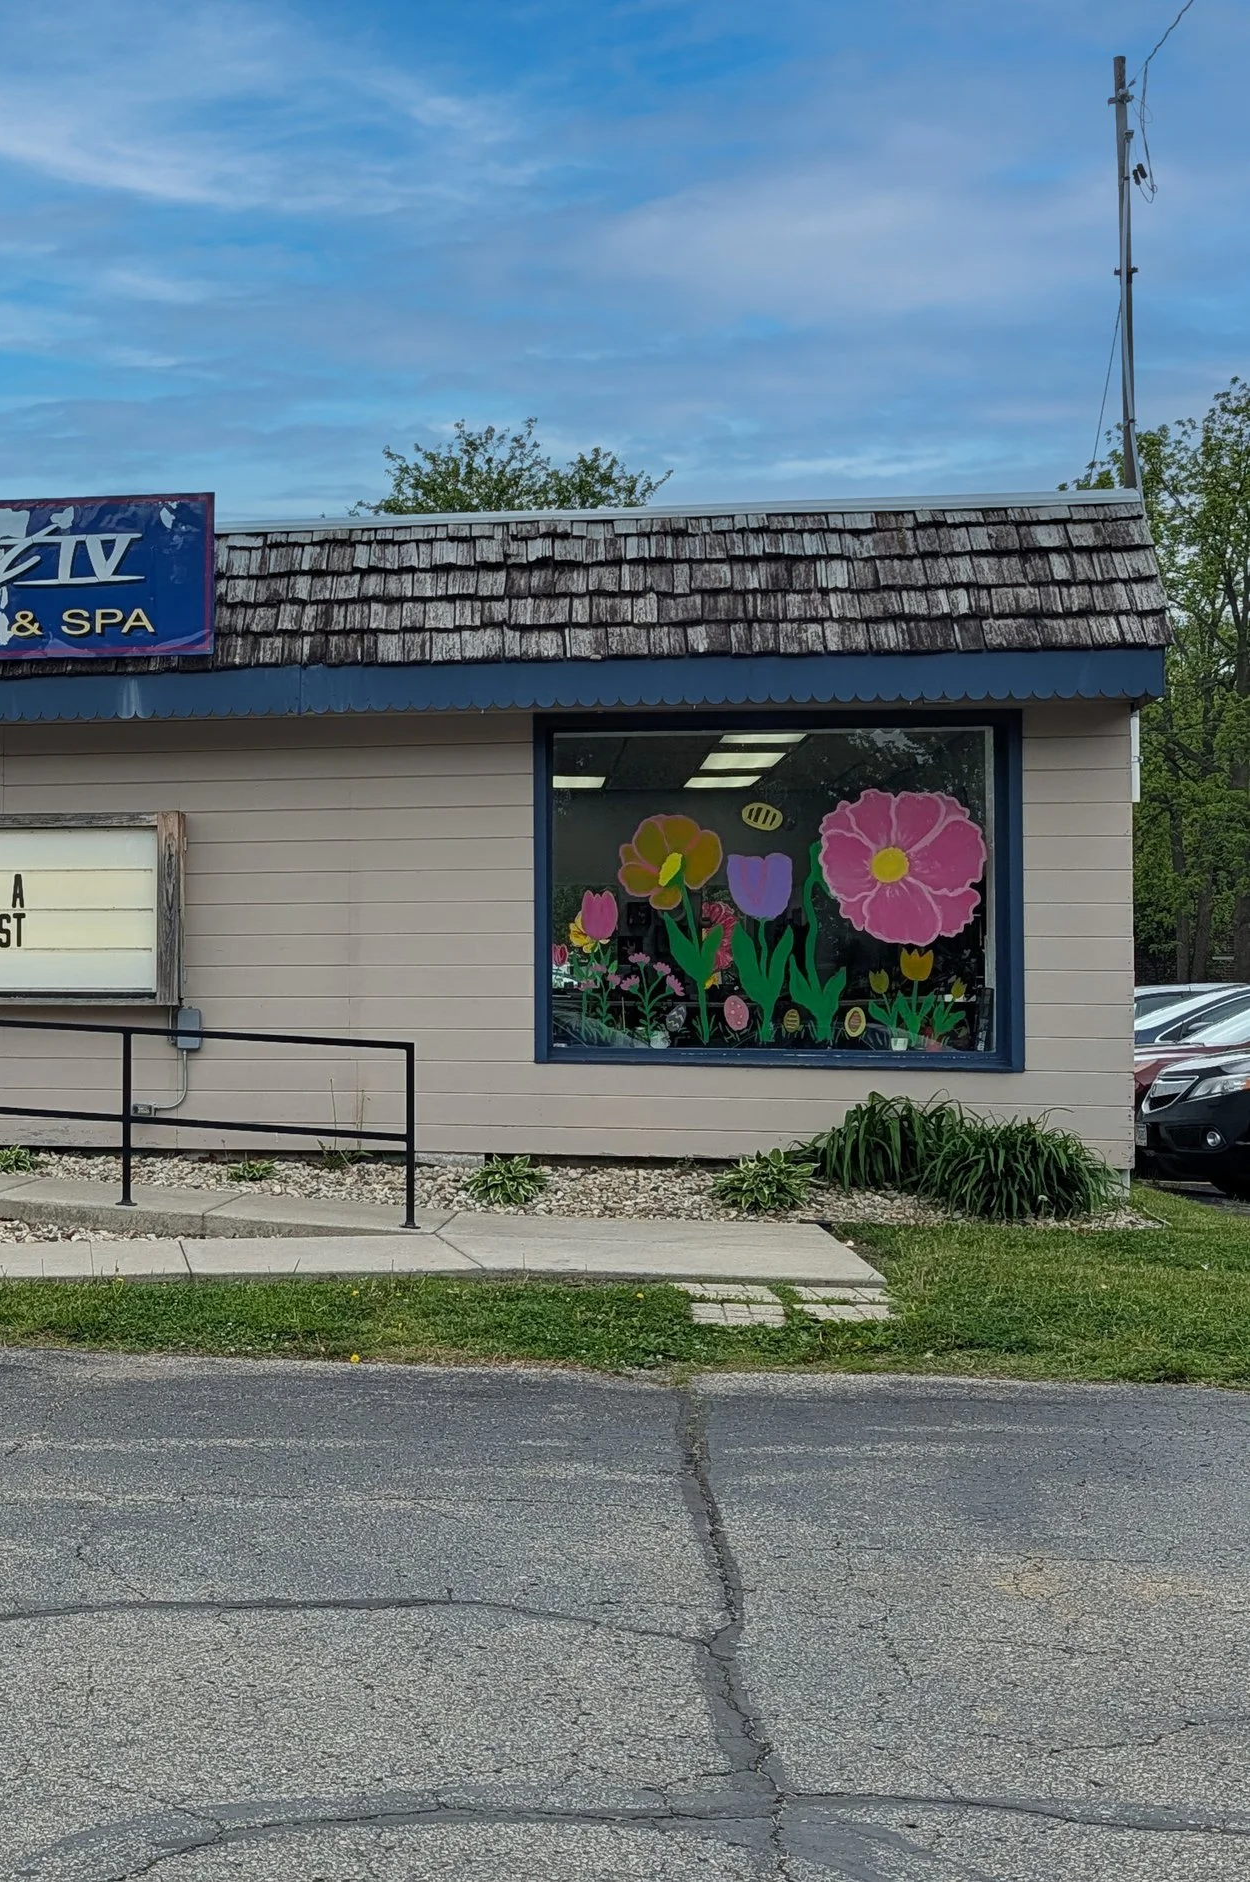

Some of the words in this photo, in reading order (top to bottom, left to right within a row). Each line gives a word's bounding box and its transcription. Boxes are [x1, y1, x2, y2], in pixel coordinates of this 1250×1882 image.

[30, 532, 145, 586] IV
[10, 610, 42, 638] &
[60, 608, 155, 635] SPA
[11, 873, 25, 909] A
